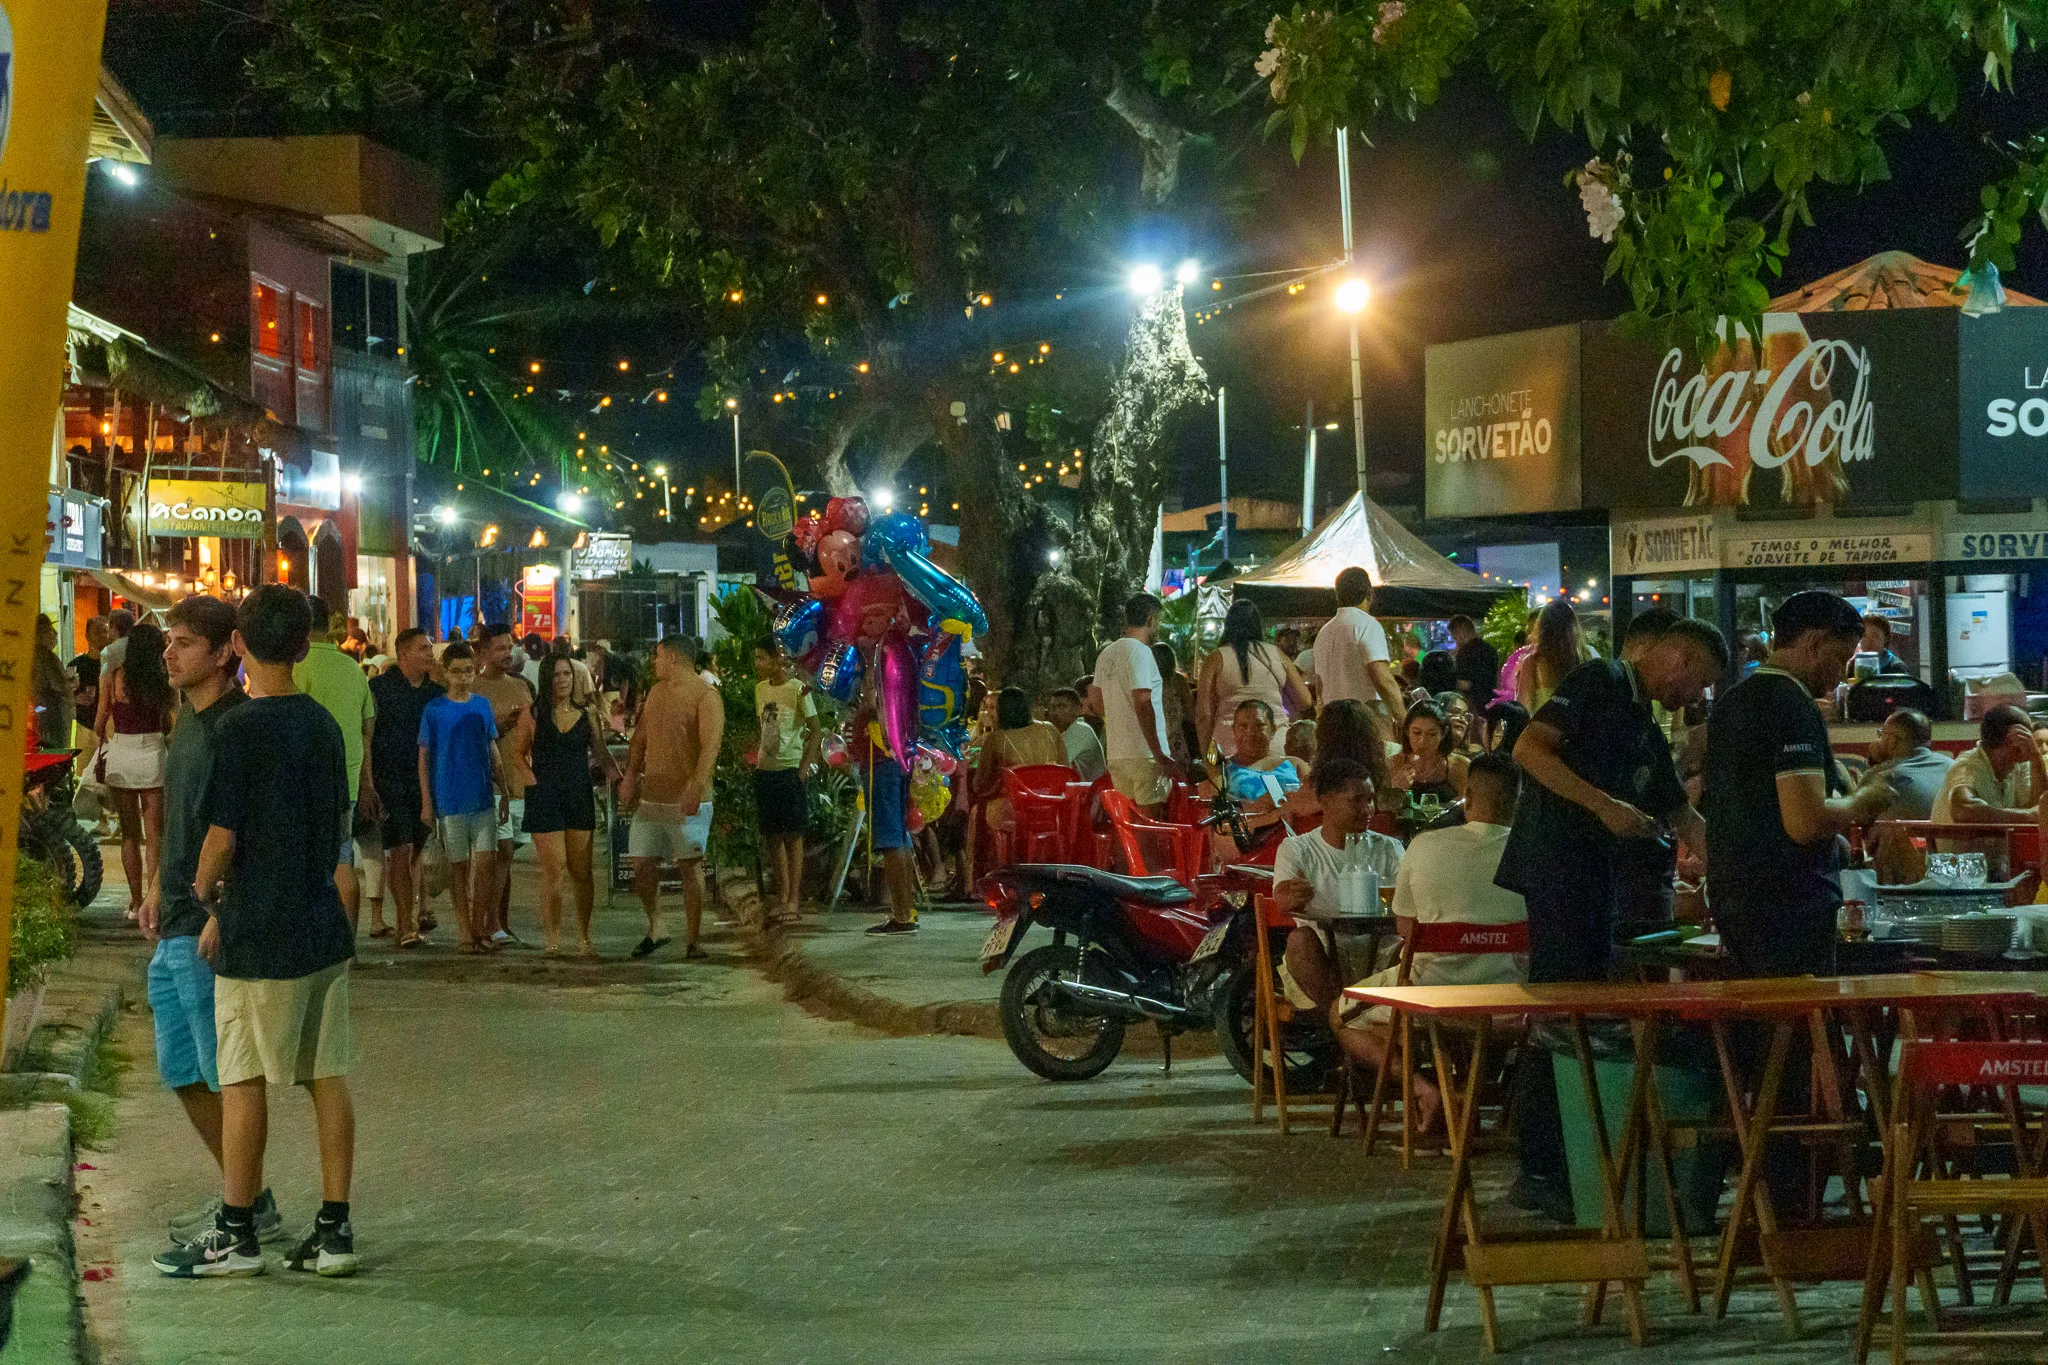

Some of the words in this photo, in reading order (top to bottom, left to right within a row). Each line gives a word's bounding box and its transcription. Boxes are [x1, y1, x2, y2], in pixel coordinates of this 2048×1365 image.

[1451, 389, 1533, 419] LANCHONETE
[1648, 339, 1875, 470] Coca-Cola
[1986, 397, 2048, 437] SO
[1434, 407, 1552, 464] SORVETÃO
[1750, 540, 1801, 552] TEMOS
[1810, 540, 1818, 551] O
[1828, 537, 1892, 550] MELHOR
[1961, 533, 2048, 557] SORV
[1744, 551, 1809, 566] SORVETE
[1819, 551, 1835, 563] DE
[1845, 550, 1897, 562] TAPIOCA
[1783, 744, 1812, 752] AMSTEL
[1460, 932, 1508, 944] AMSTEL
